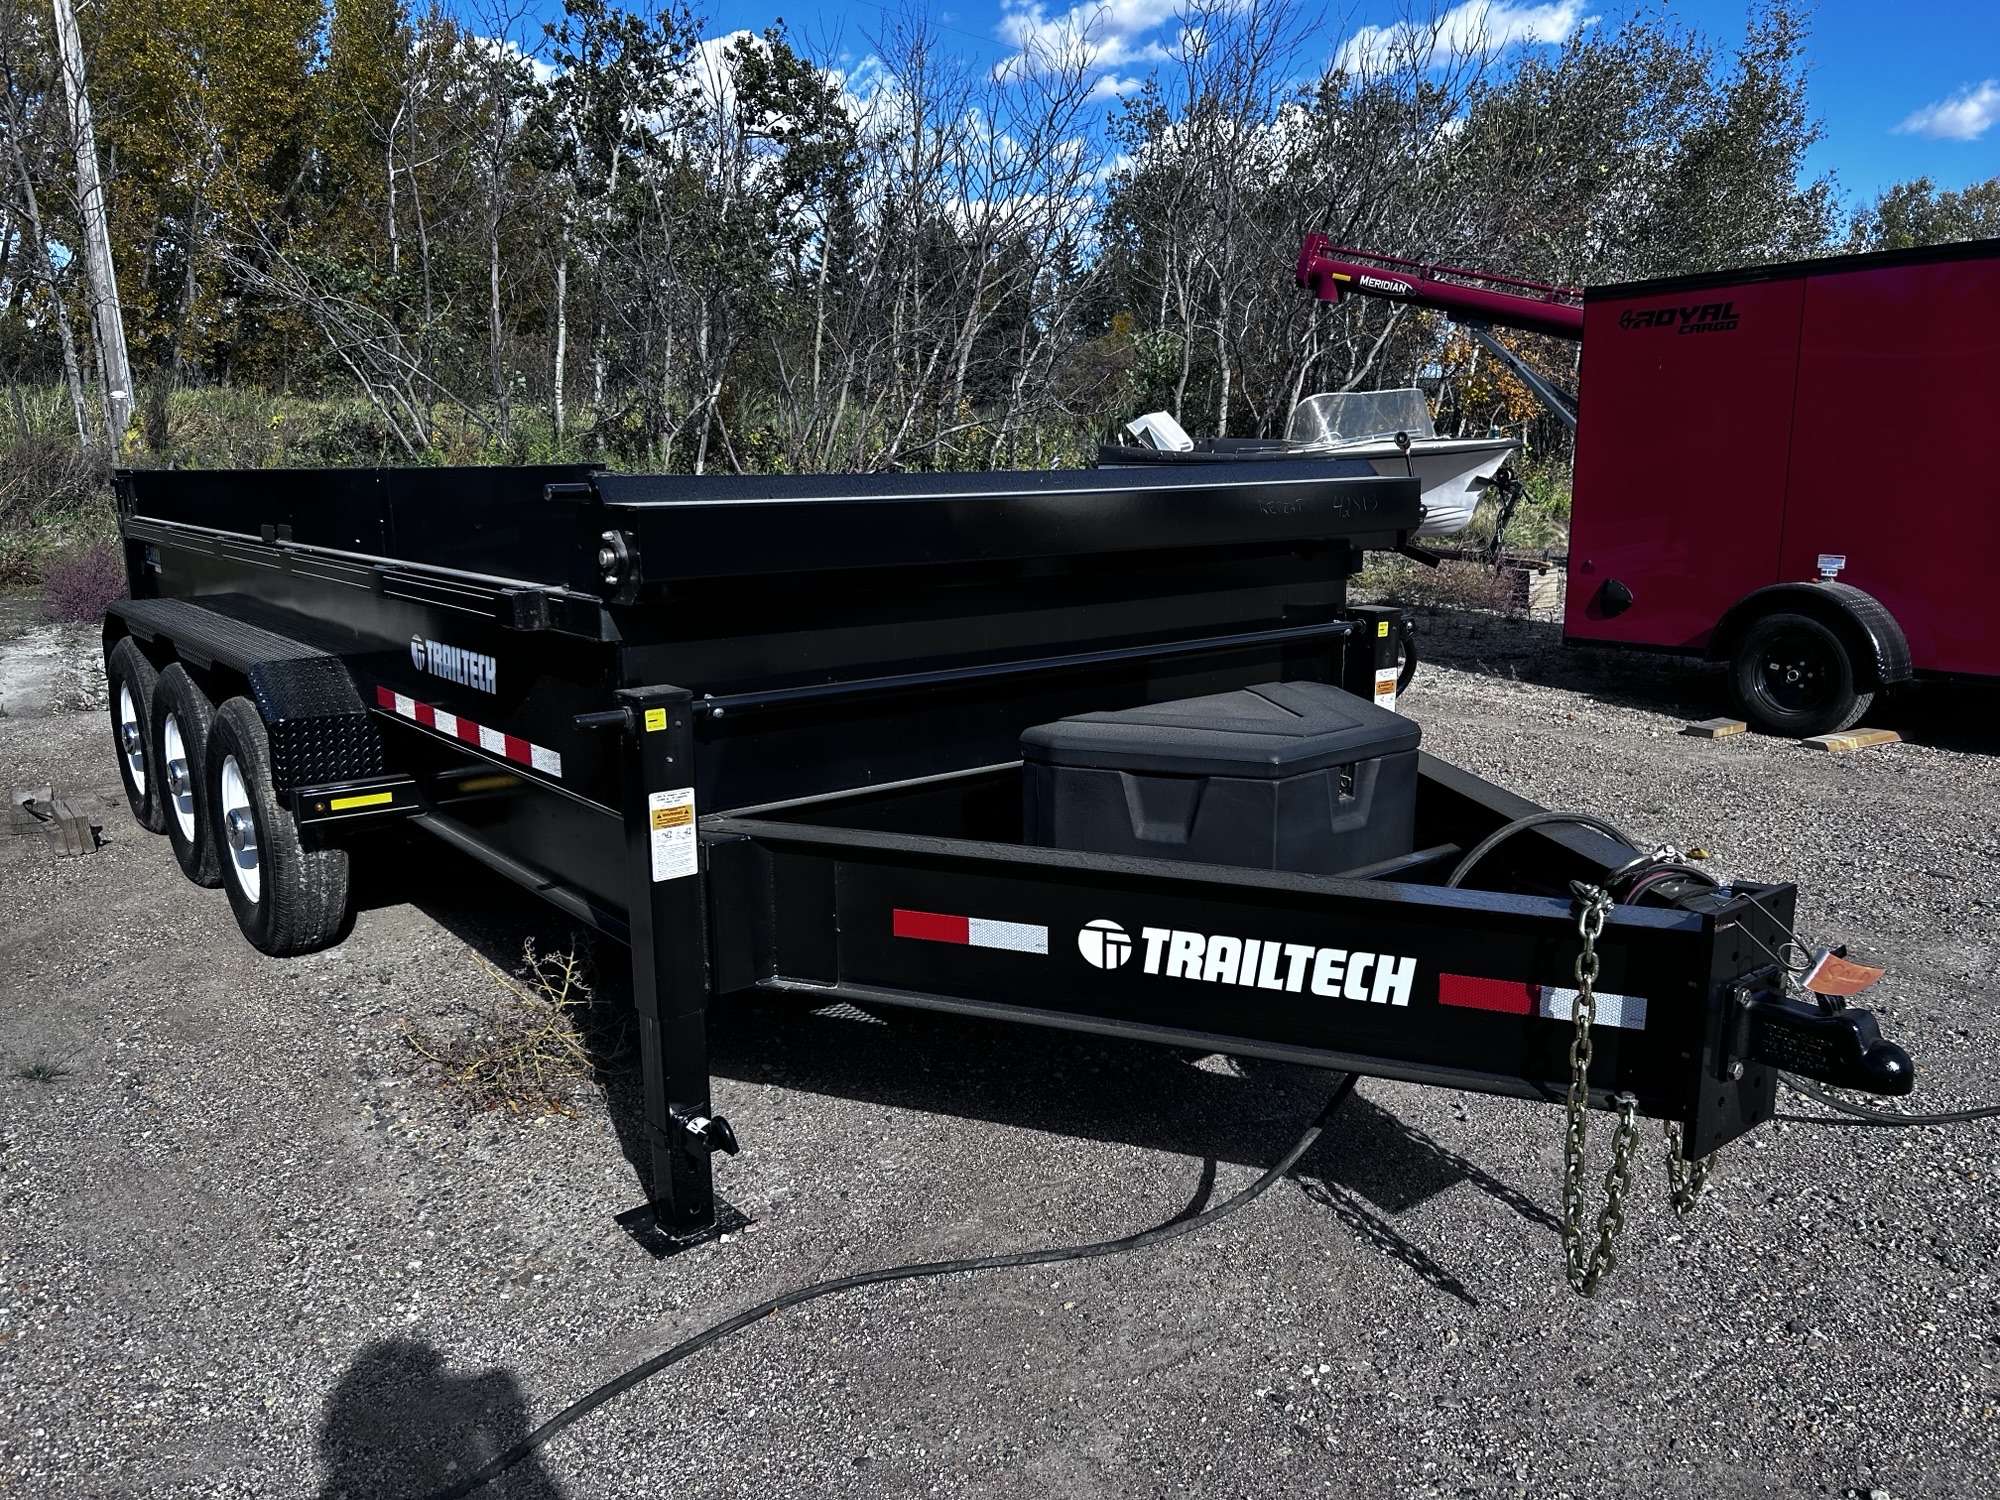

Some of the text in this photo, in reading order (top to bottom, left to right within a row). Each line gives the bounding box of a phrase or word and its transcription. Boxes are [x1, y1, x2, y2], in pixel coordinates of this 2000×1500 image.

[1360, 275, 1407, 293] MERIDIAN
[1630, 301, 1739, 329] ROYAL
[1678, 320, 1738, 335] CARGO
[425, 639, 497, 695] TRAILTECH
[1141, 926, 1417, 1007] TRAILTECH
